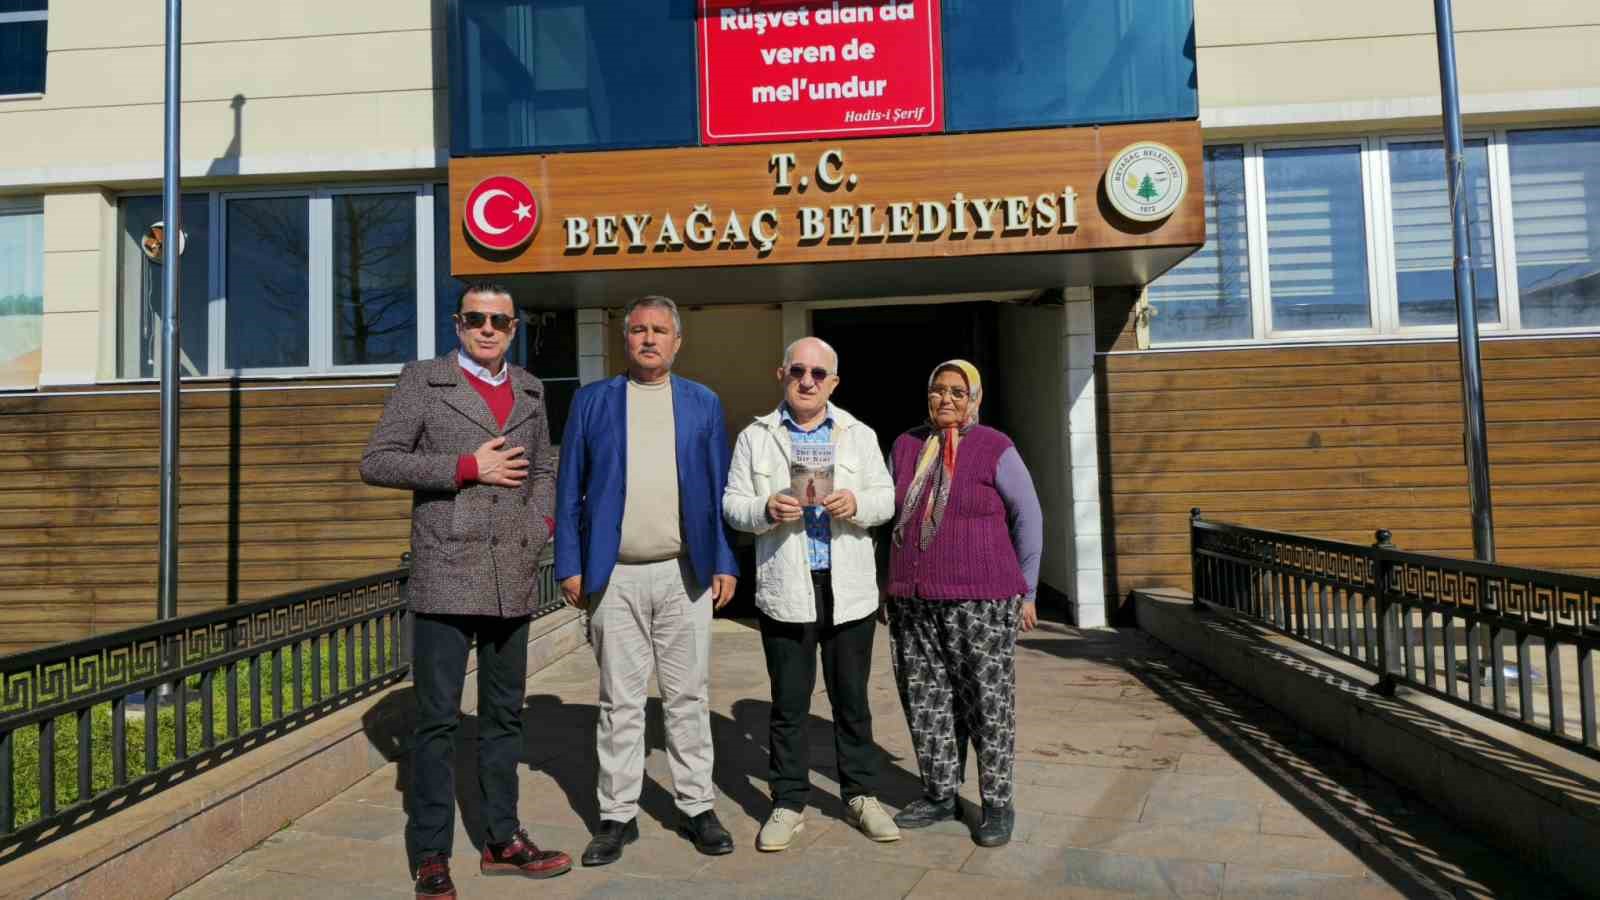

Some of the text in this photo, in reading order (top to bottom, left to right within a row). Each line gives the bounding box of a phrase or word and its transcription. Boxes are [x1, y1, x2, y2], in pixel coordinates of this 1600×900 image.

[719, 0, 915, 35] Rüşvet alan da
[760, 38, 876, 65] veren de
[844, 106, 925, 123] Hadis-i Şerif
[566, 185, 1079, 252] BEYAĞAÇ BELEDİYESİ
